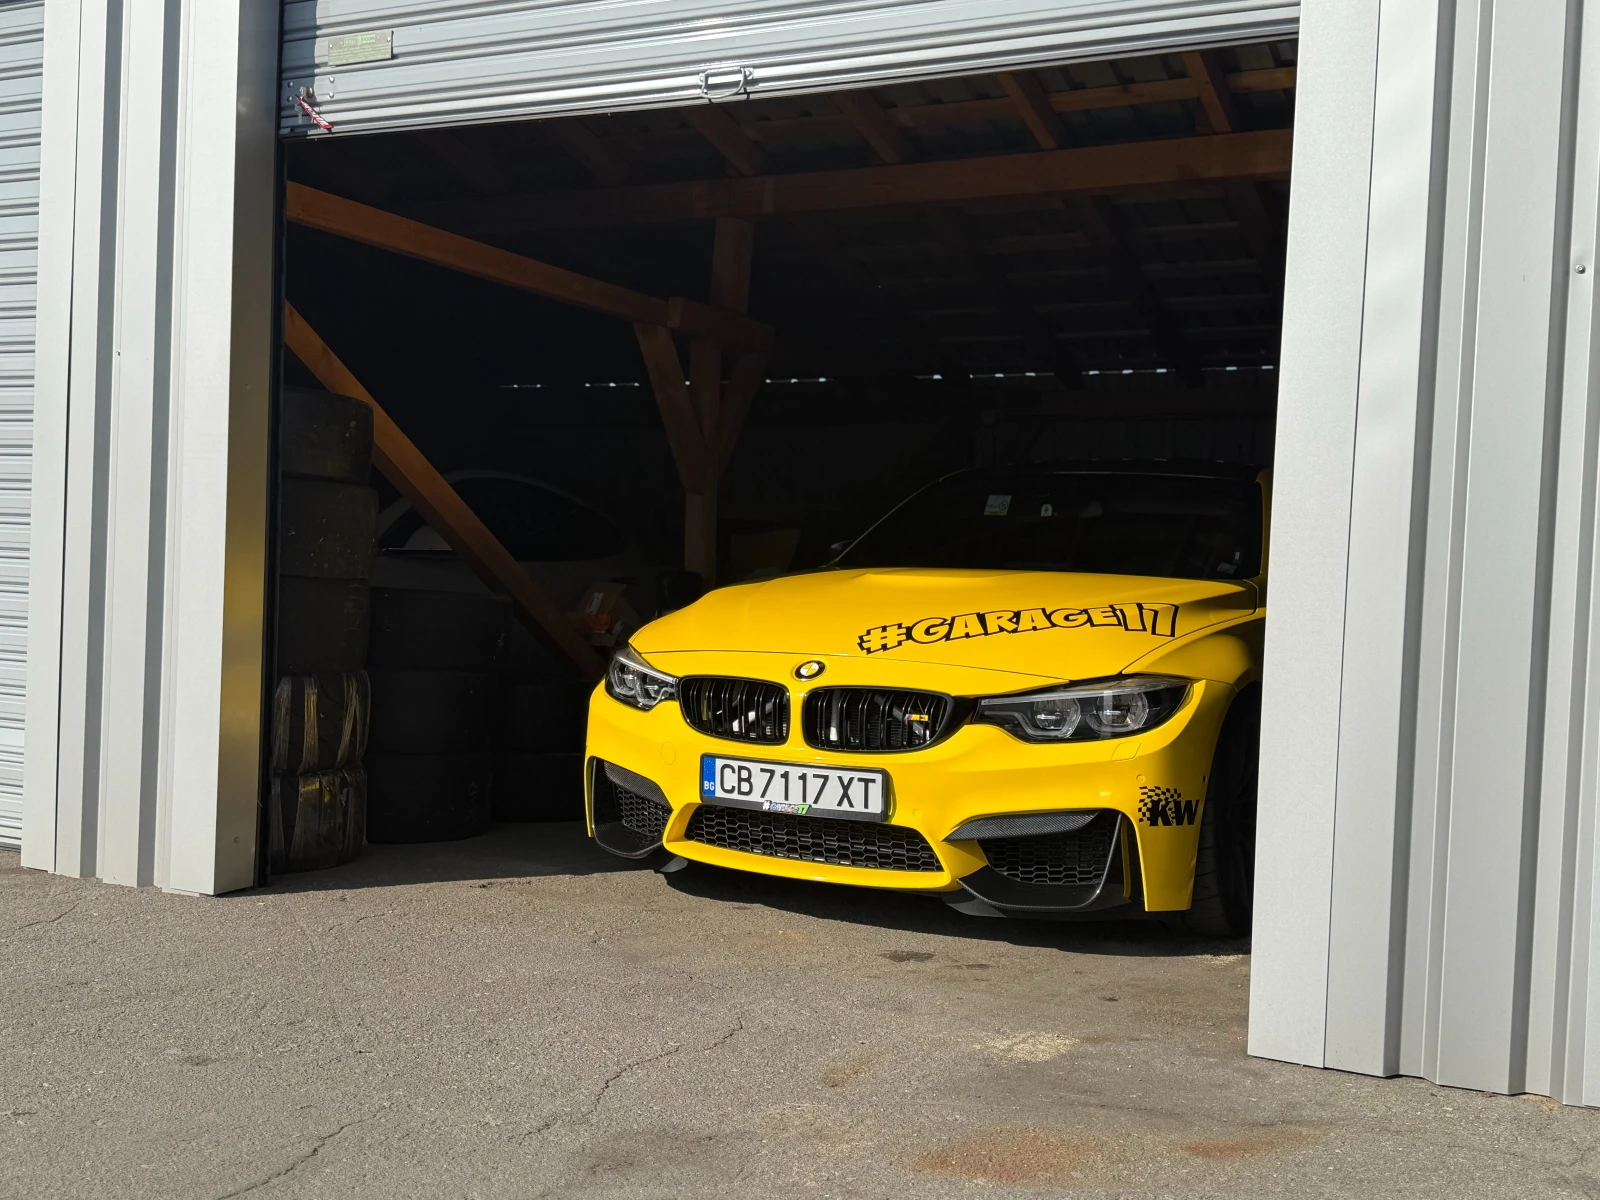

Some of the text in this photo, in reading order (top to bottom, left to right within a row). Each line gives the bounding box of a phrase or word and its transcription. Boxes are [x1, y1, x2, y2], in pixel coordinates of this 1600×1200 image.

[857, 602, 1180, 655] #GARAGE17
[703, 780, 715, 791] BG
[719, 763, 876, 809] CB 7117 XT
[1149, 799, 1200, 826] KW
